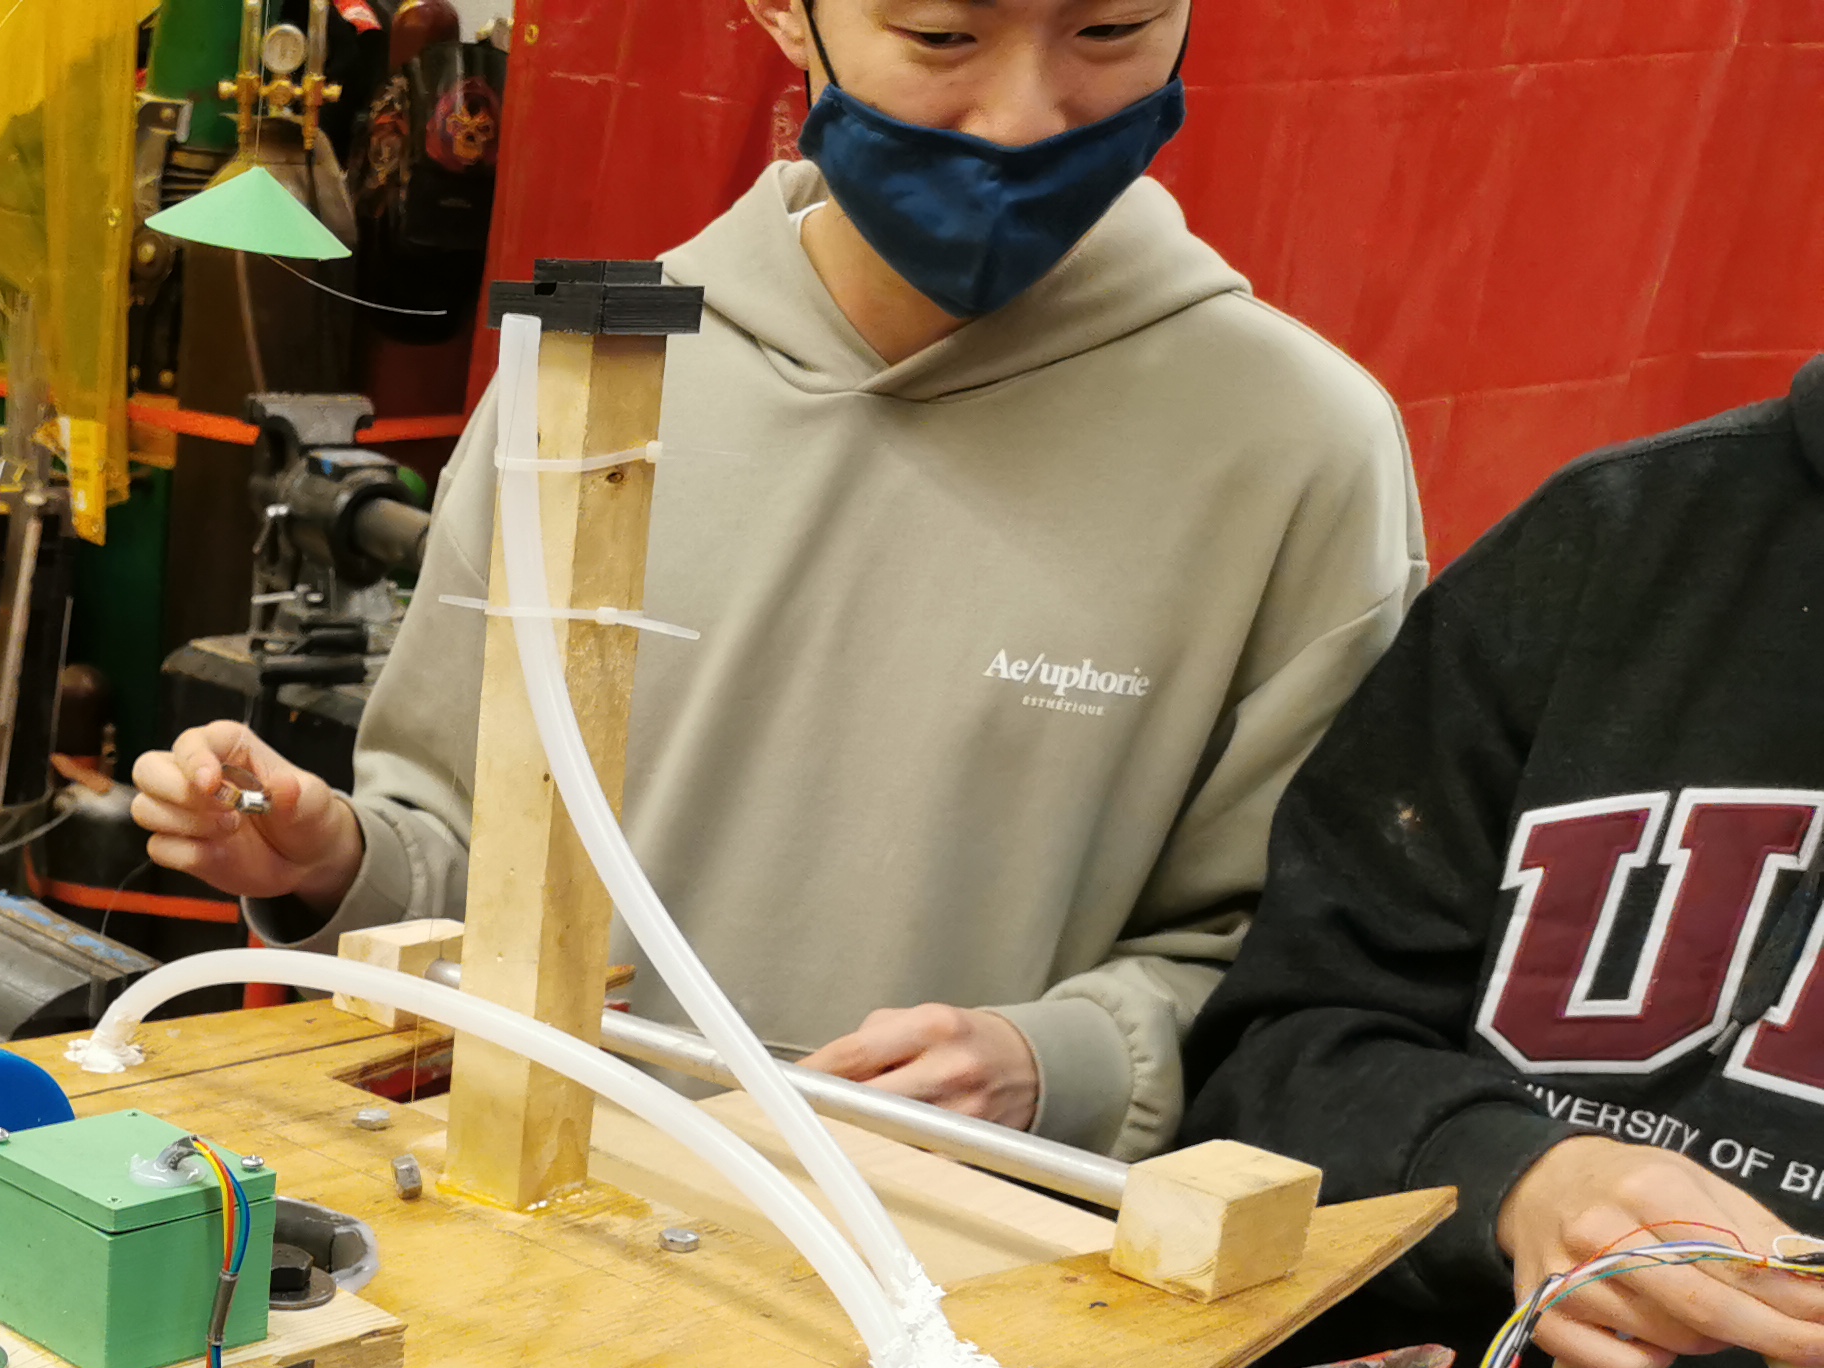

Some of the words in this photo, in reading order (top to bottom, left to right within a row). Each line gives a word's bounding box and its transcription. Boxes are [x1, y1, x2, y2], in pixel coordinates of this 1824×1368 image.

[982, 648, 1150, 697] Ae/uphorie
[1512, 1079, 1701, 1155] VERSITY
[1710, 1138, 1775, 1178] OF
